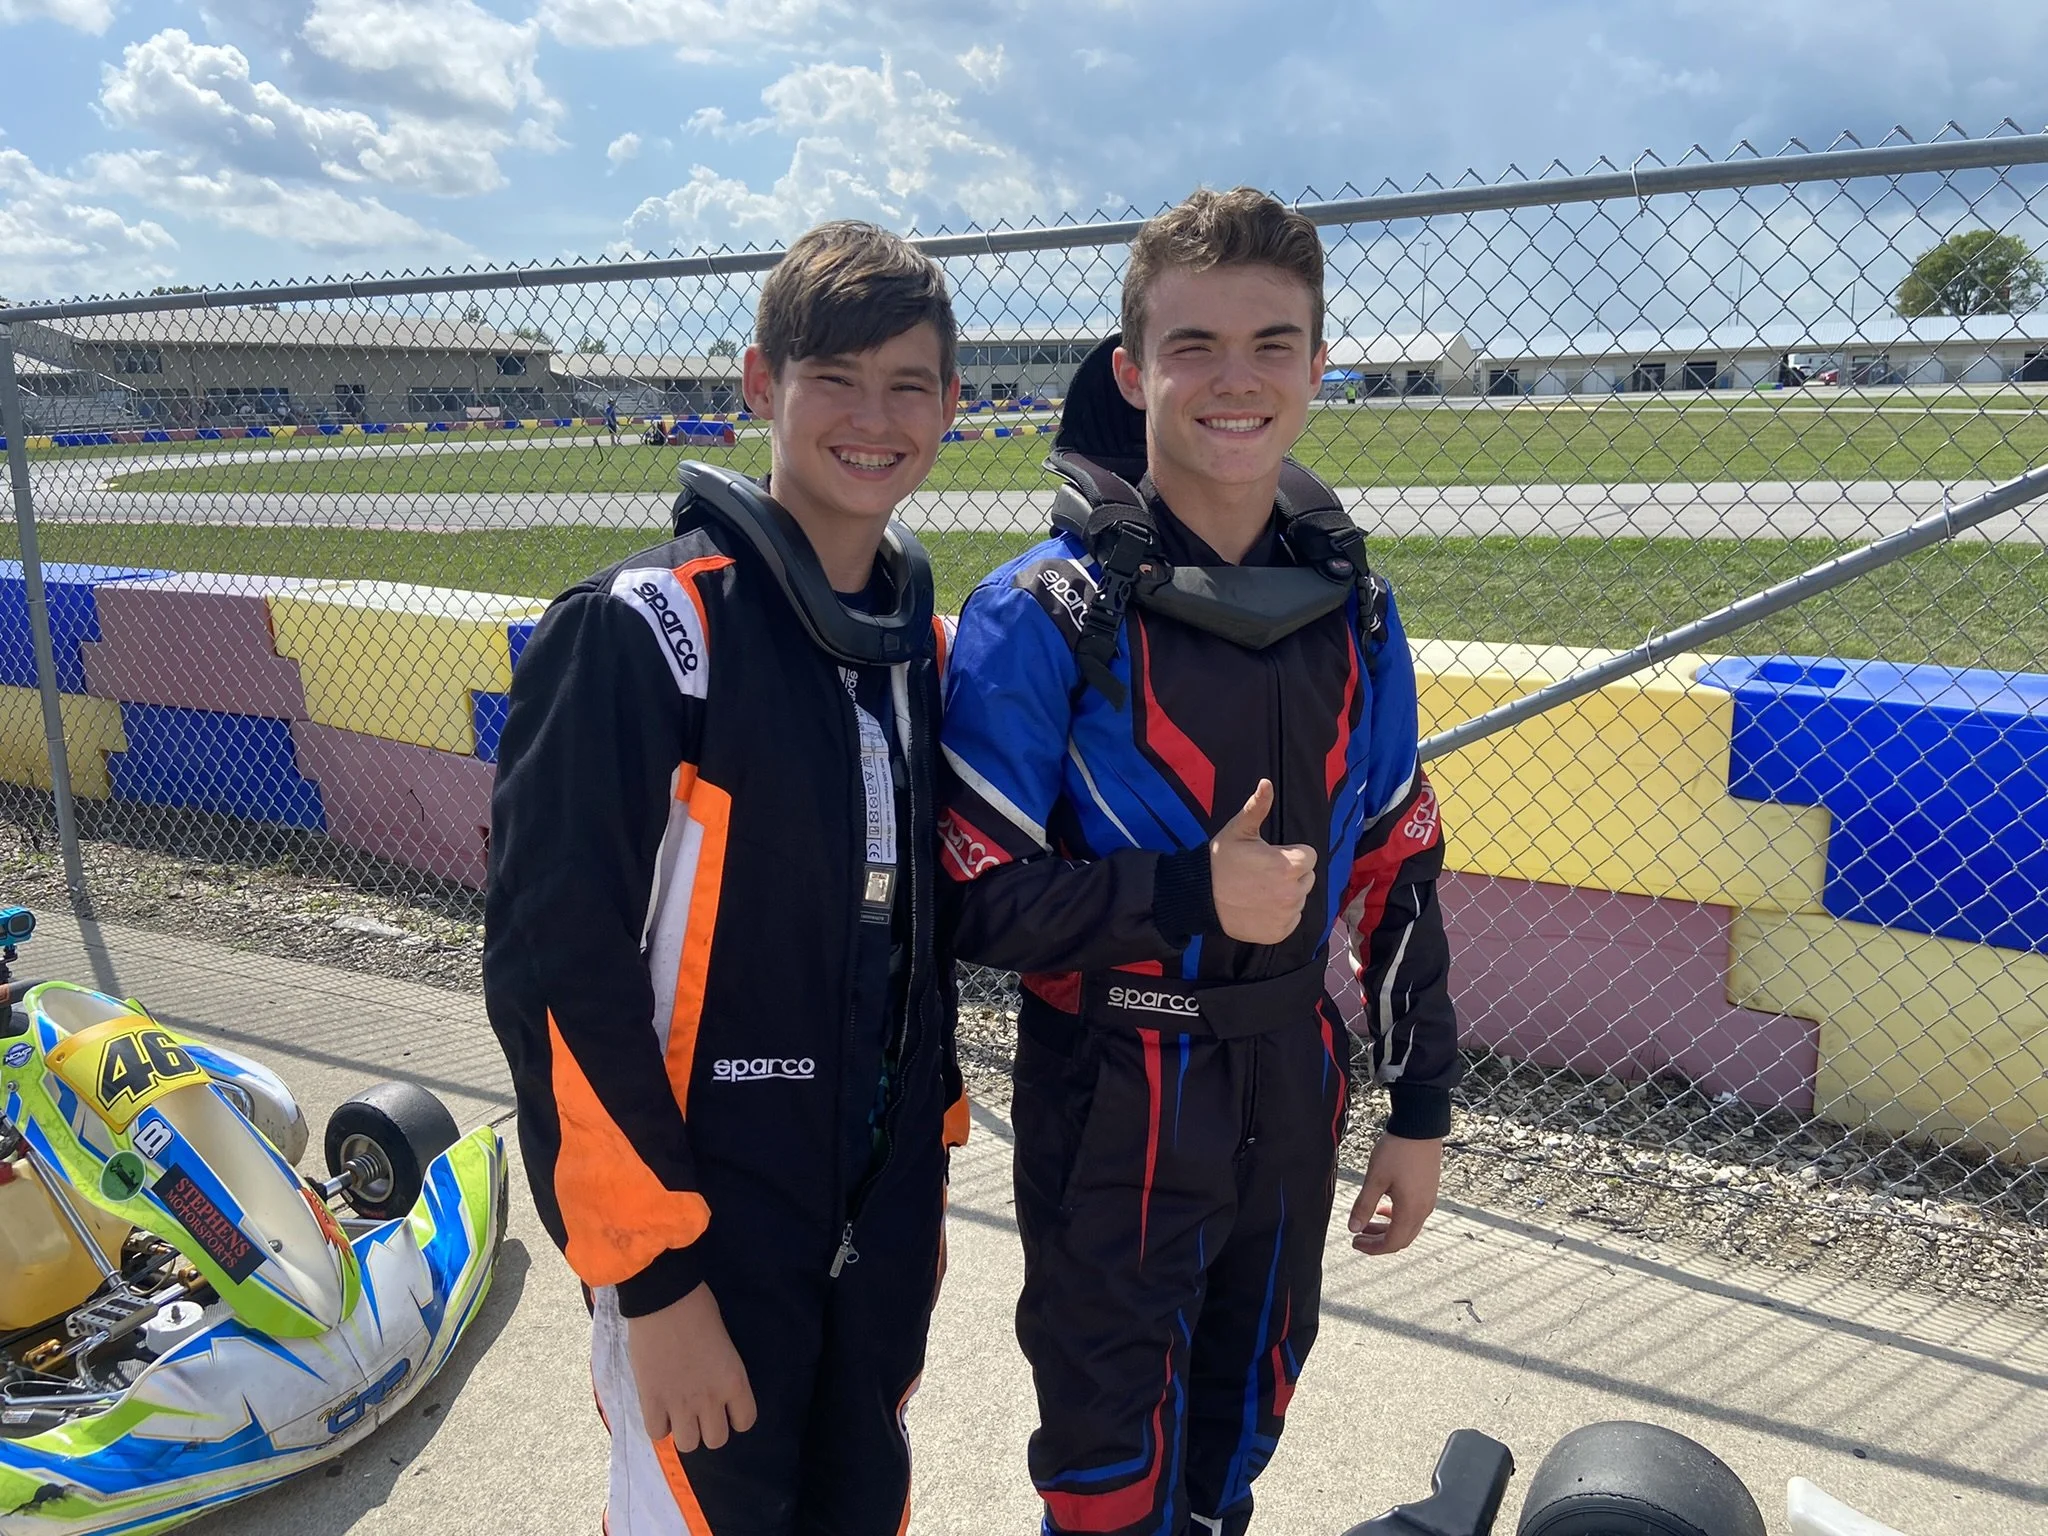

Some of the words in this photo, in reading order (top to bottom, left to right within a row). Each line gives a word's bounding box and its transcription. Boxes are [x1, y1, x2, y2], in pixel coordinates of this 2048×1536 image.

[636, 582, 698, 674] sparco
[1108, 986, 1200, 1014] sparco
[98, 1031, 200, 1108] 46
[712, 1057, 816, 1082] sparco
[165, 1188, 238, 1268] MOTORSPORTS
[176, 1177, 250, 1258] STEPHENS
